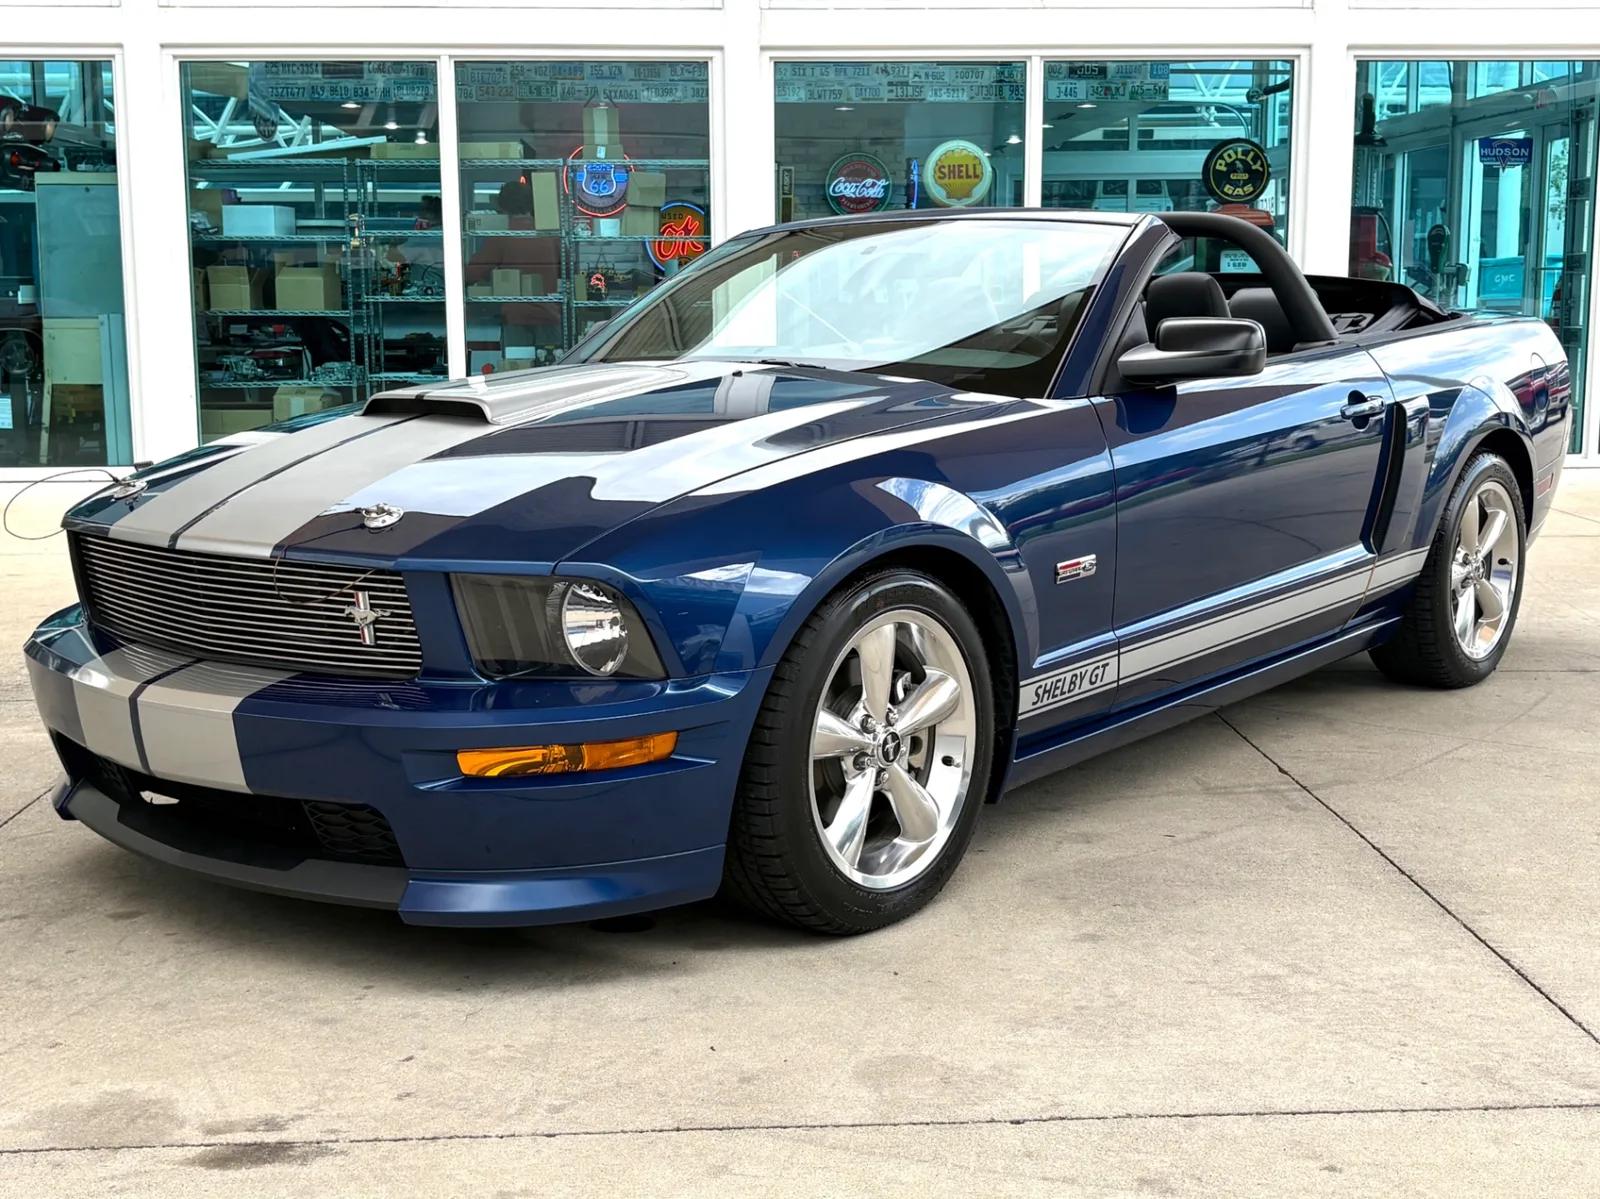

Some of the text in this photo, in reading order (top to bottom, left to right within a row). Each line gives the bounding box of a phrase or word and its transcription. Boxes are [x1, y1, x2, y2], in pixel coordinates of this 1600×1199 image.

[1215, 147, 1264, 172] POLLY
[1480, 147, 1529, 157] HUDSON
[937, 163, 980, 180] SHELL
[590, 179, 609, 194] 66
[830, 176, 890, 199] Coca-Cola
[1223, 183, 1254, 196] GAS
[655, 215, 704, 261] OK
[1031, 662, 1110, 707] SHELBY GT
